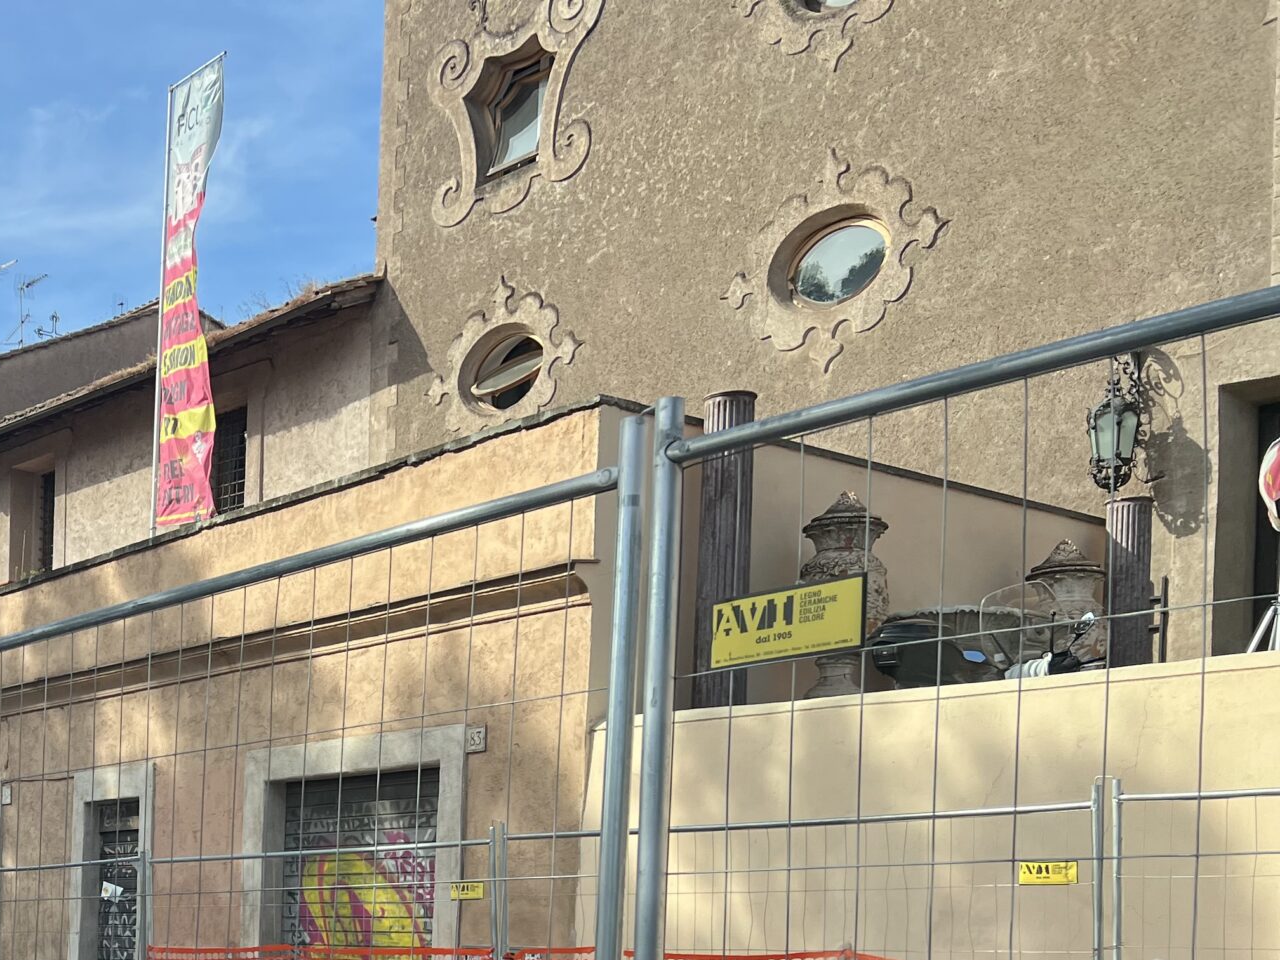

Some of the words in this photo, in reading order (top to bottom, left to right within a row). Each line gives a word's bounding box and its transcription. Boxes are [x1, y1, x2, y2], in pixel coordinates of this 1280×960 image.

[800, 589, 822, 600] LEGNO
[799, 612, 825, 624] COLORE
[755, 633, 770, 644] dal
[773, 630, 793, 641] 1905
